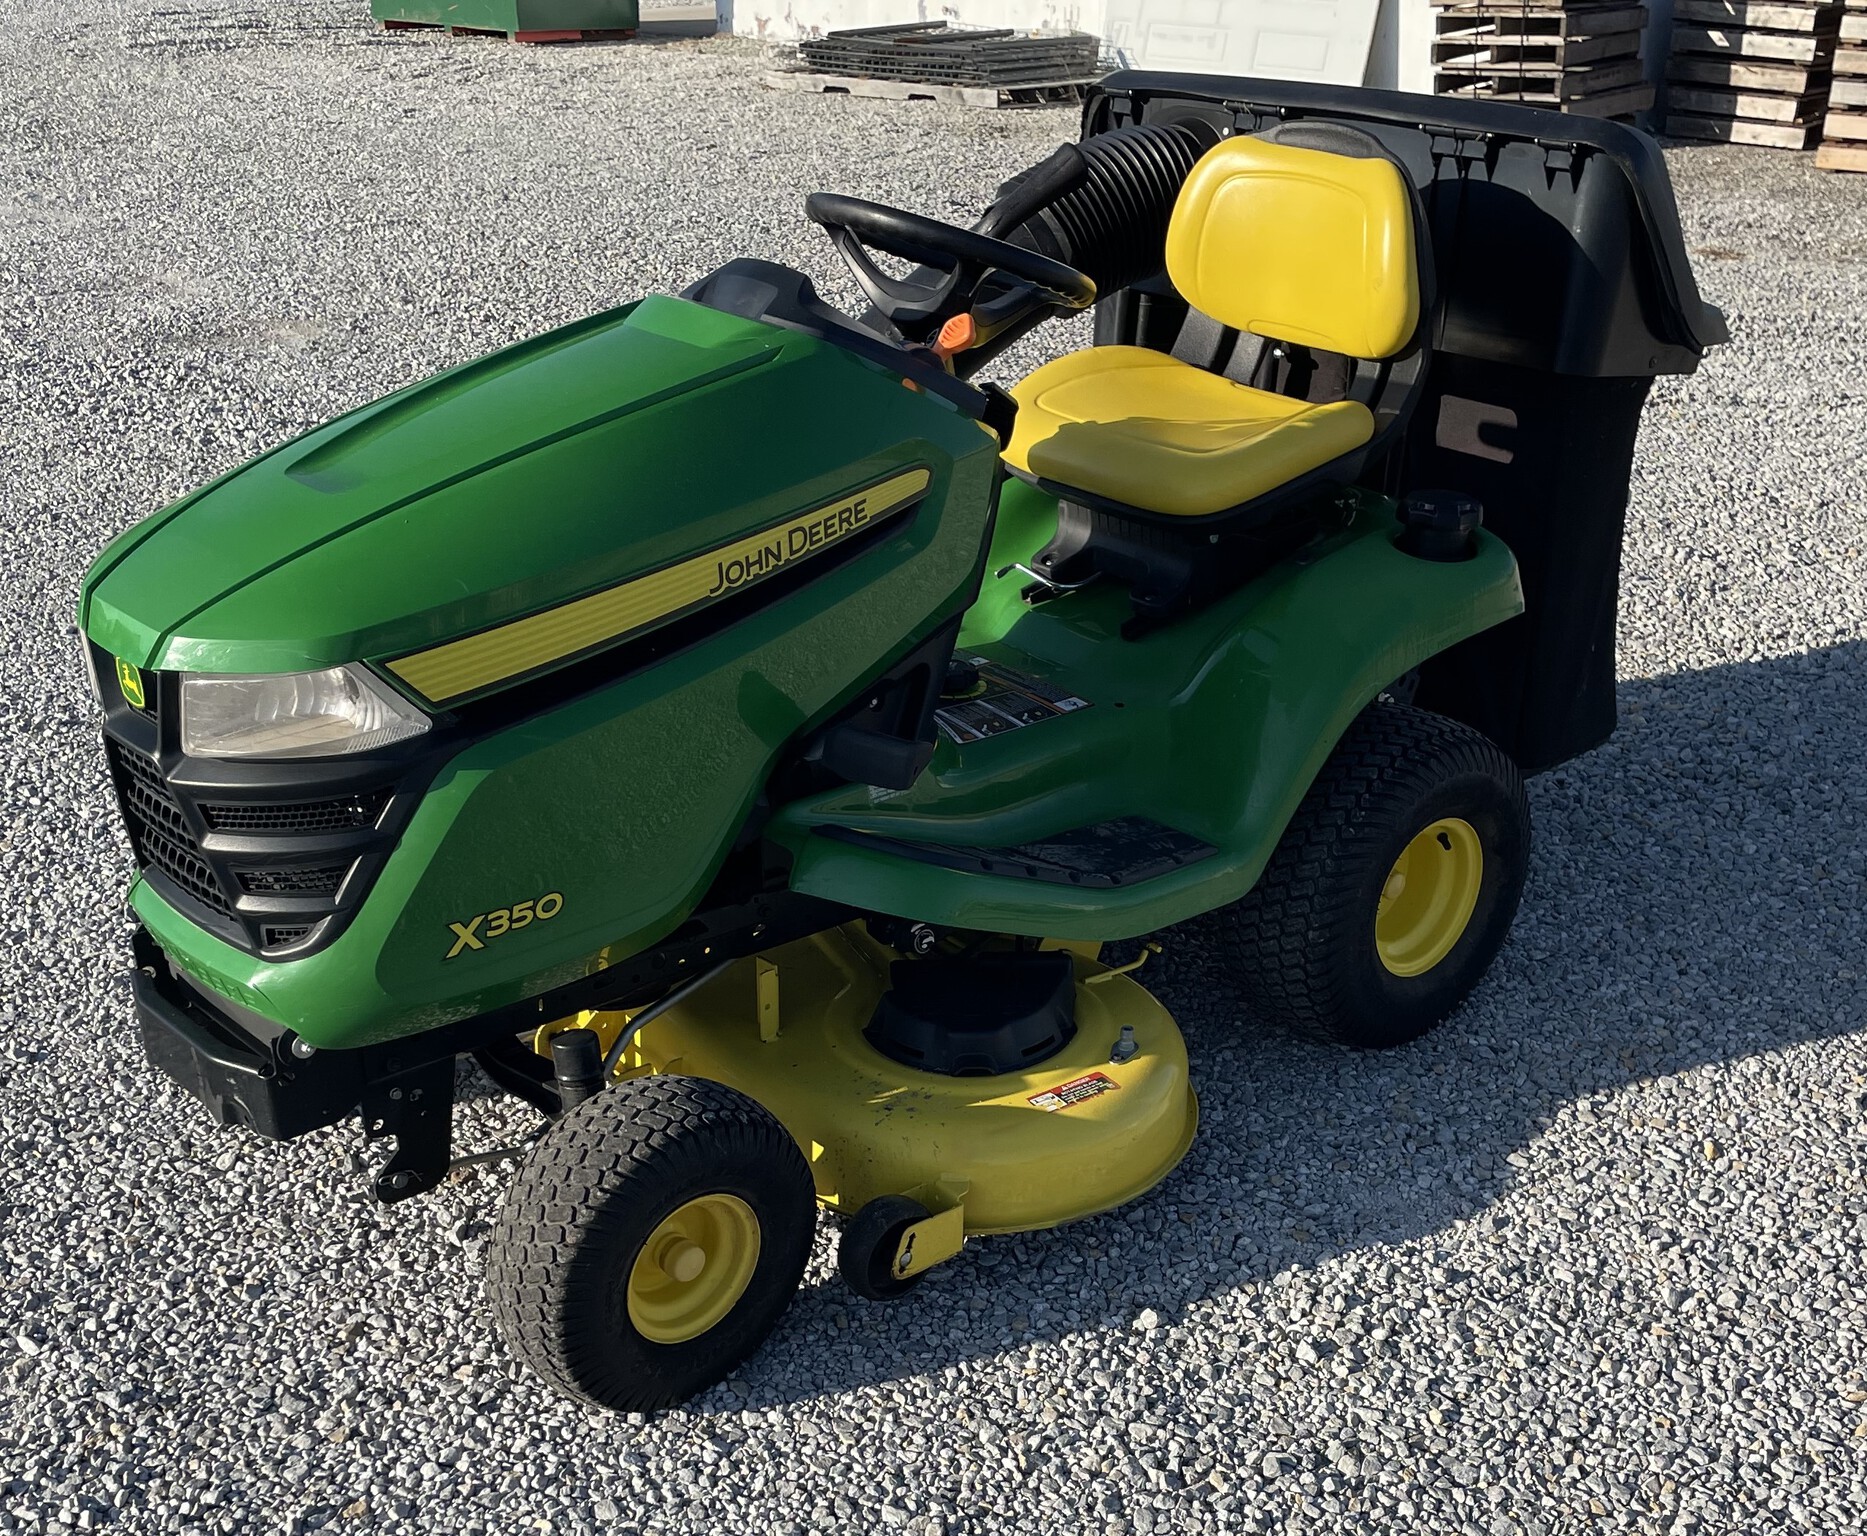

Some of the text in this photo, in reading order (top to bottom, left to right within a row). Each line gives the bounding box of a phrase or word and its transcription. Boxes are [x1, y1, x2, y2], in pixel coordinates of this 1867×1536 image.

[709, 498, 869, 596] JOHN DEERE
[446, 892, 564, 959] X350
